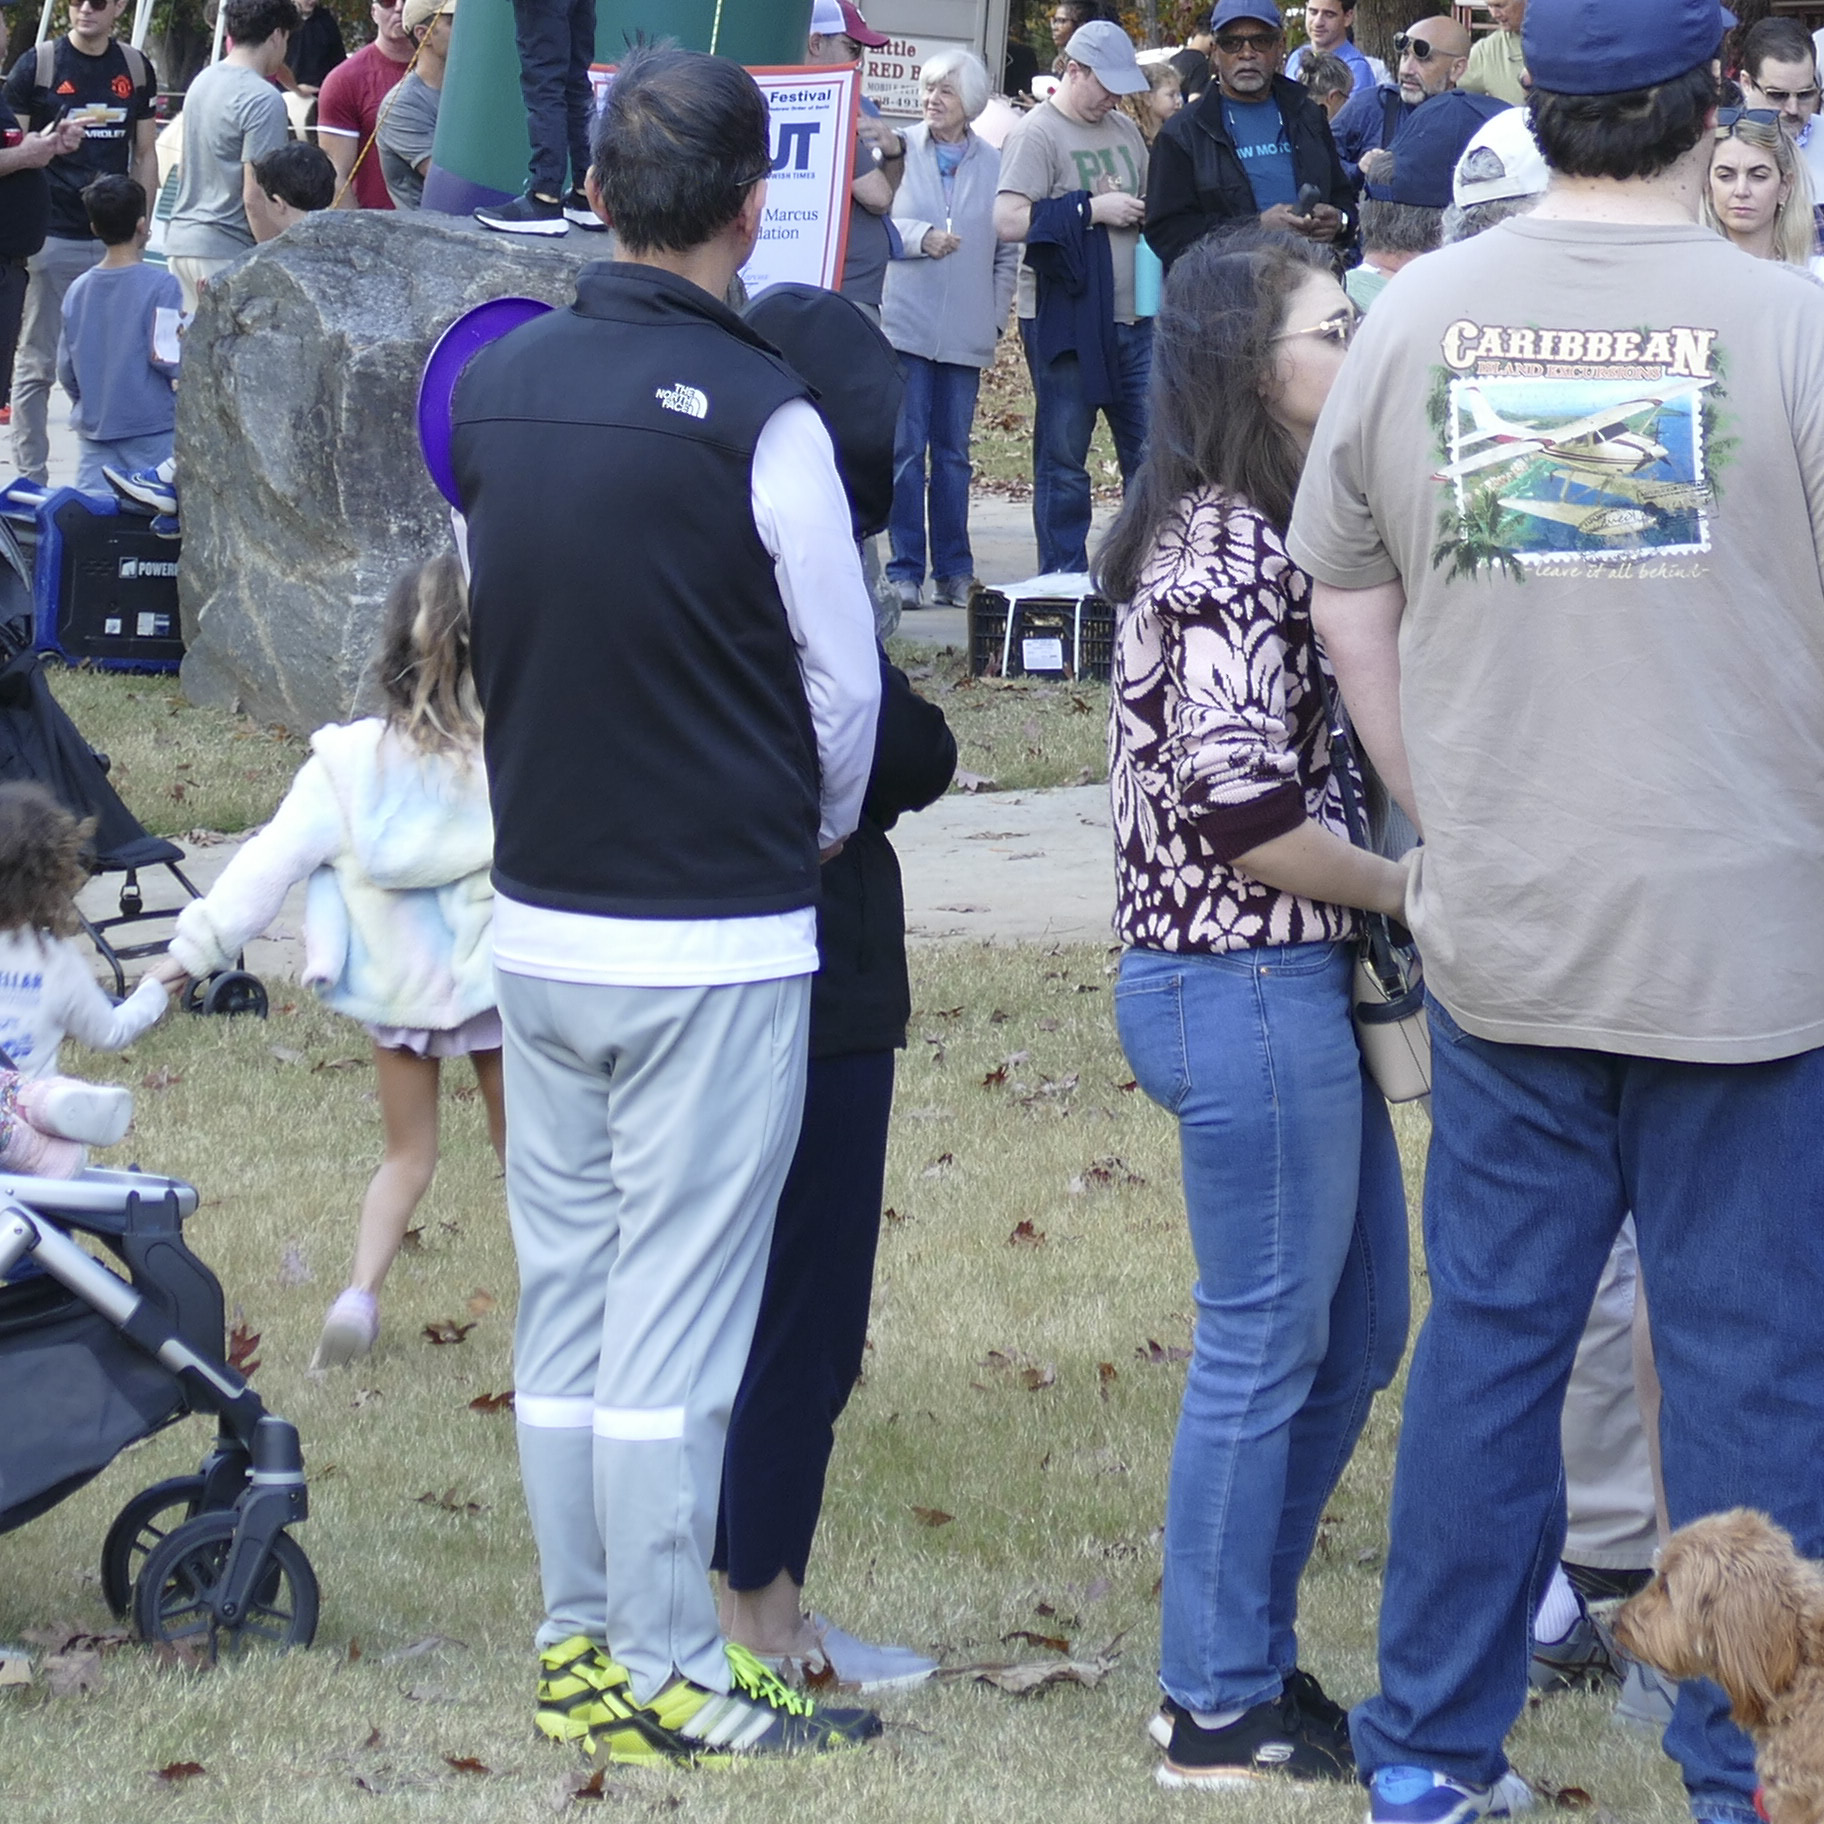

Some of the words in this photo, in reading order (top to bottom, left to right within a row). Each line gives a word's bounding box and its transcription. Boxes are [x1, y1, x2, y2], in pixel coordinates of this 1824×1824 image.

[868, 61, 904, 79] RED
[770, 89, 832, 103] Festival
[84, 129, 126, 138] VROLET
[772, 122, 820, 171] JT
[769, 172, 791, 180] WISH
[764, 208, 819, 222] Marcus
[757, 226, 799, 240] dation
[1441, 319, 1717, 378] CARIBBEAN
[1477, 360, 1545, 376] ISLAND
[1546, 364, 1662, 381] EXCURSIONS
[675, 383, 695, 396] THE
[656, 388, 693, 406] NORTH
[662, 399, 690, 414] FACE
[138, 562, 178, 576] POWER
[1586, 563, 1606, 578] it
[1607, 563, 1633, 579] all
